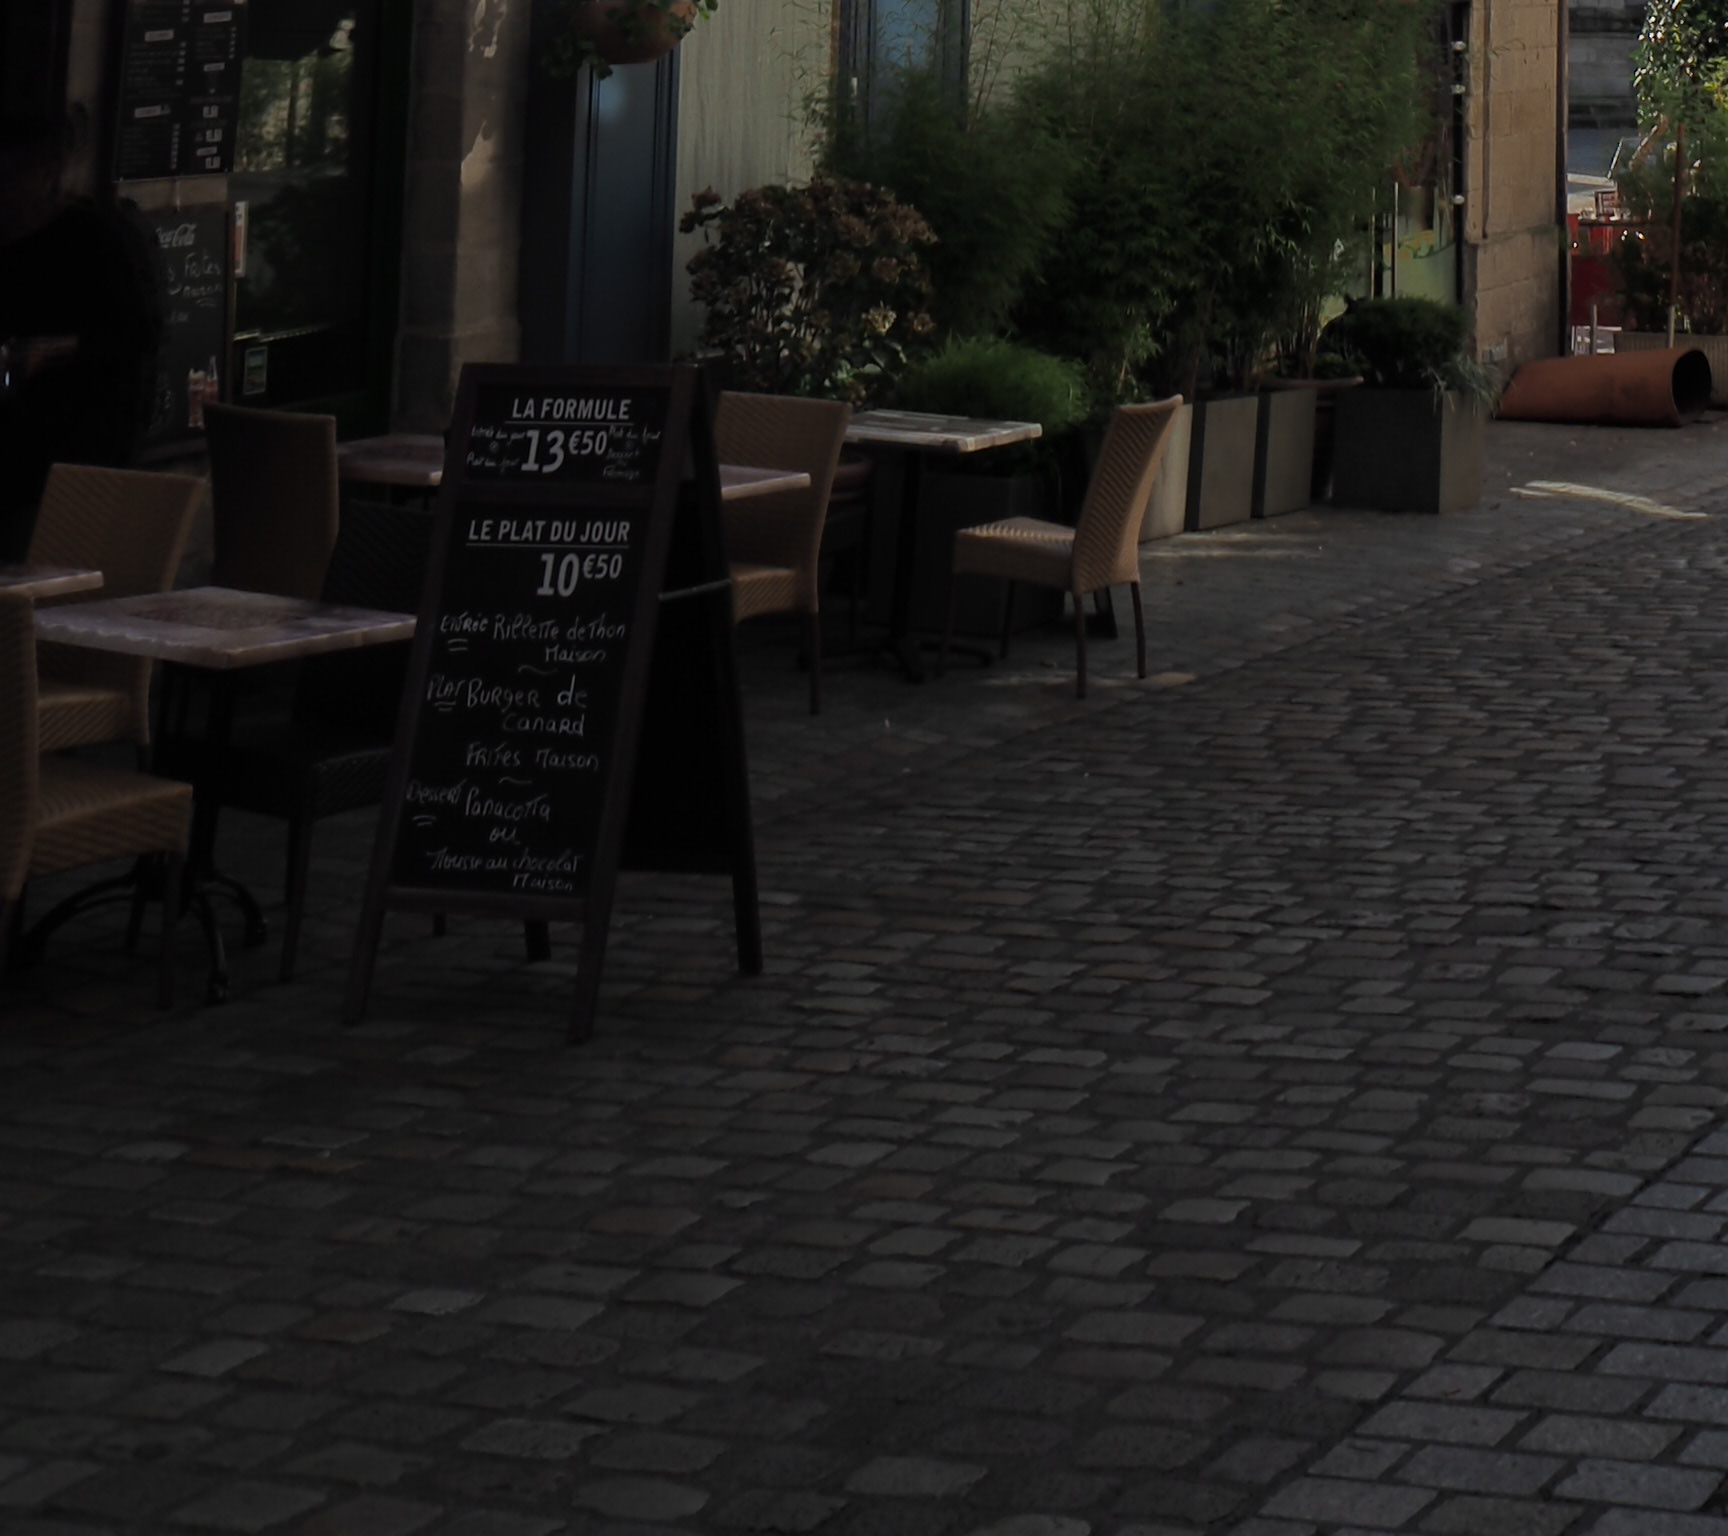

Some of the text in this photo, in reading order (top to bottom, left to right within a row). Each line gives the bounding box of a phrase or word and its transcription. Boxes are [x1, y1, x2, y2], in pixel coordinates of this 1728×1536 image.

[512, 397, 632, 420] LA FORMULE
[468, 519, 631, 543] LE PLAT DU JOUR
